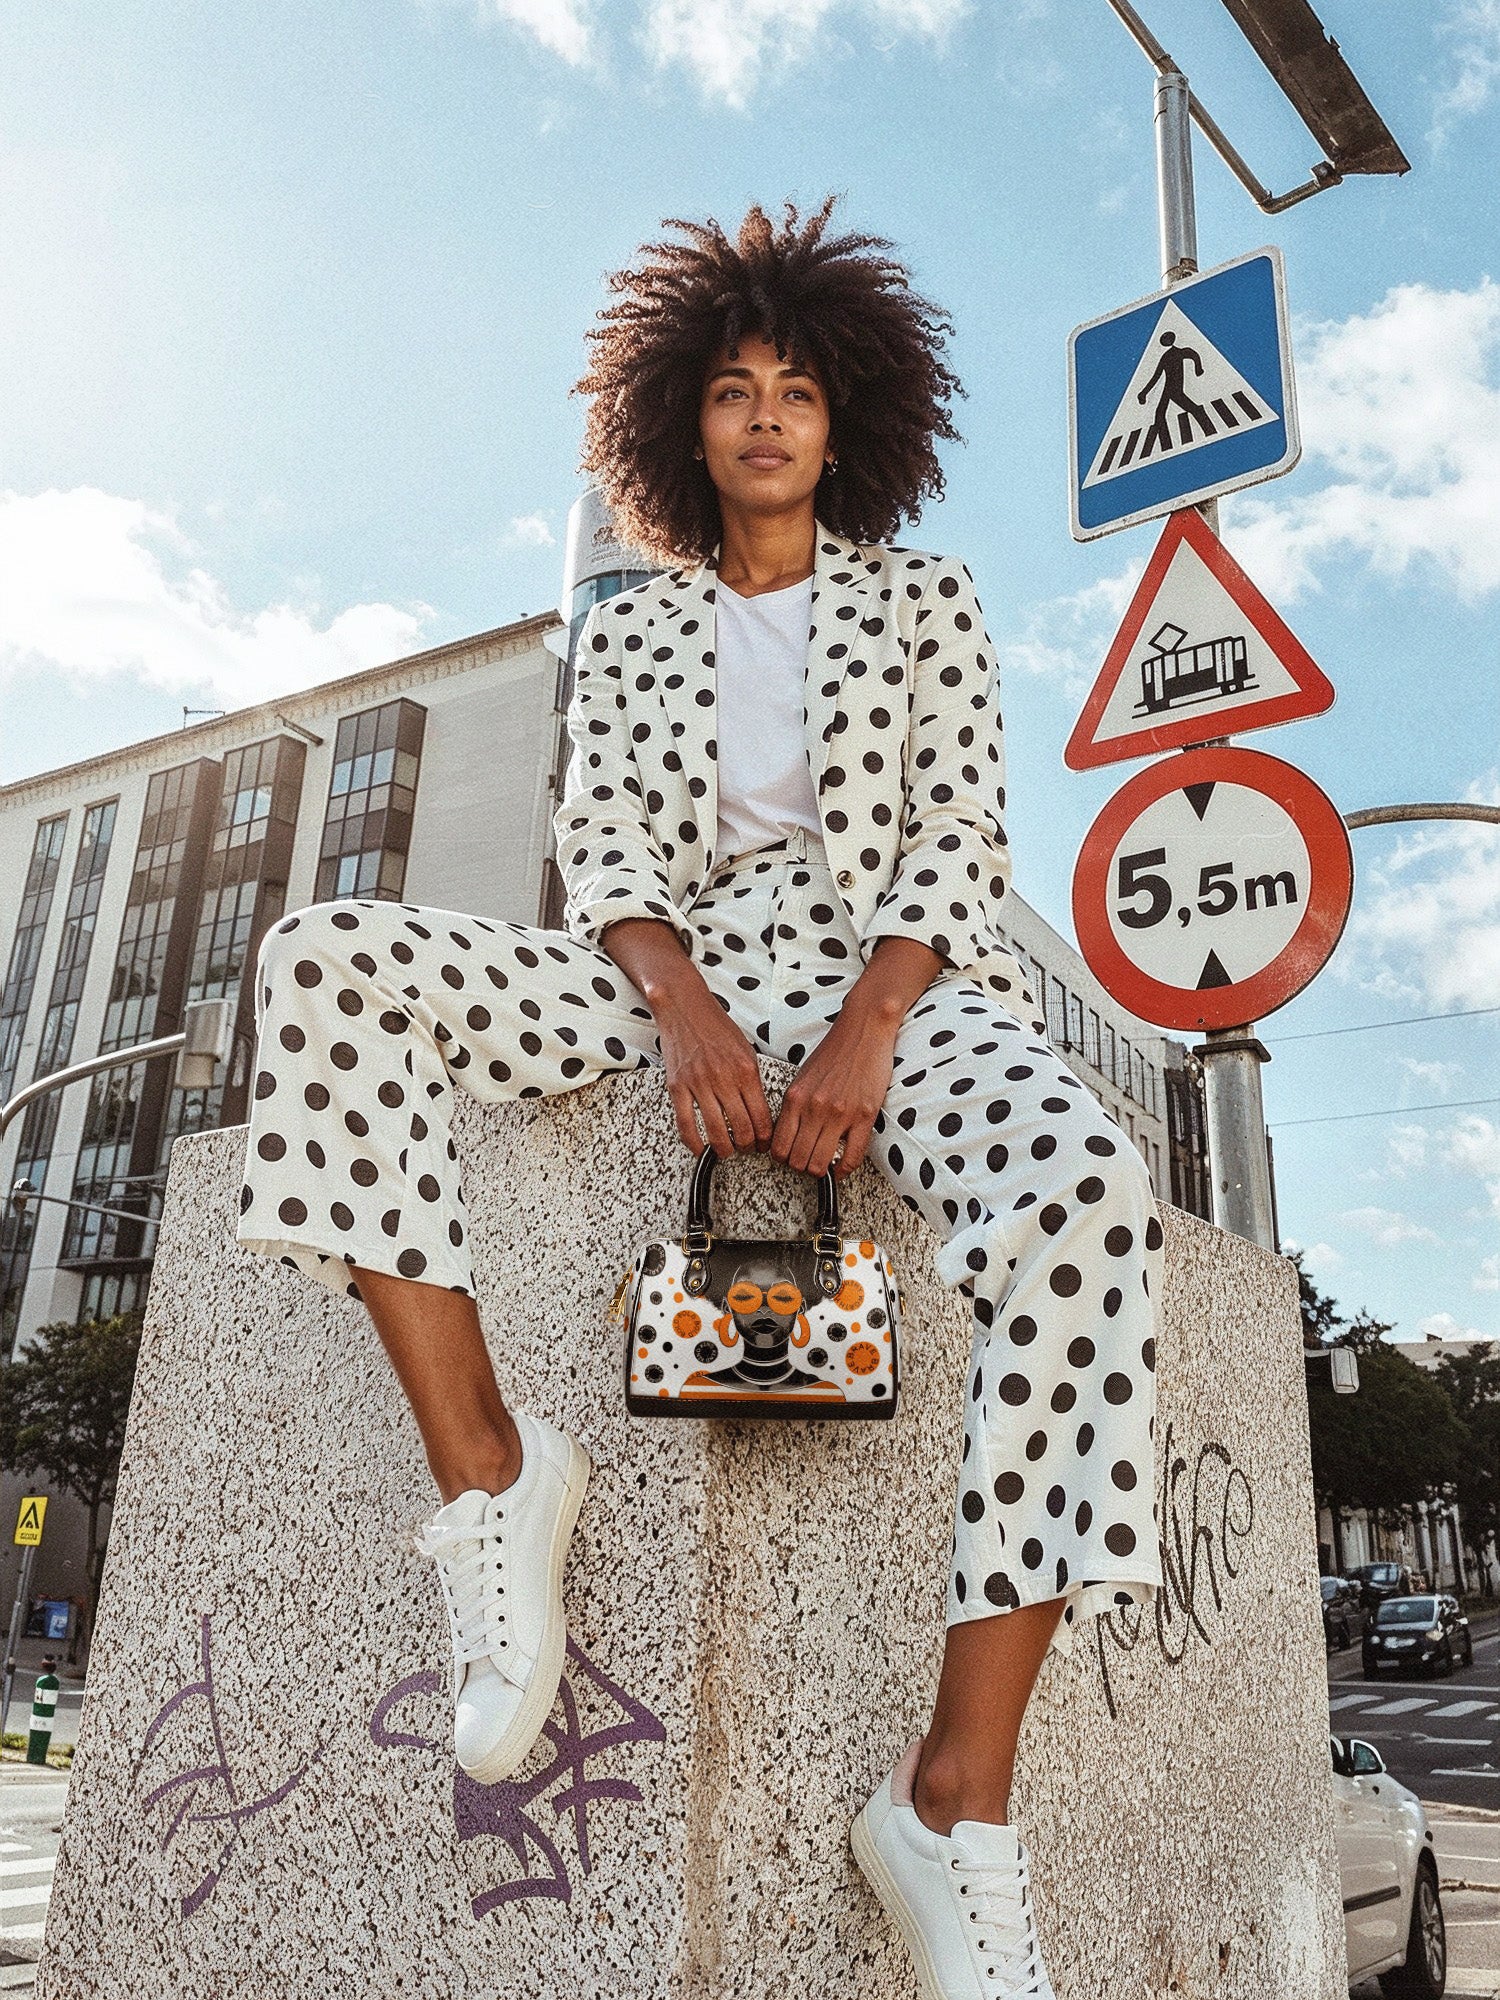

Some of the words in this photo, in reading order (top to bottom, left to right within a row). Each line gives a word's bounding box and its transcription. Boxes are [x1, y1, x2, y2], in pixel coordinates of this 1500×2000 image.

[1117, 847, 1298, 929] 5,5m
[847, 1343, 877, 1359] BRAVE
[847, 1359, 879, 1374] BRAVE
